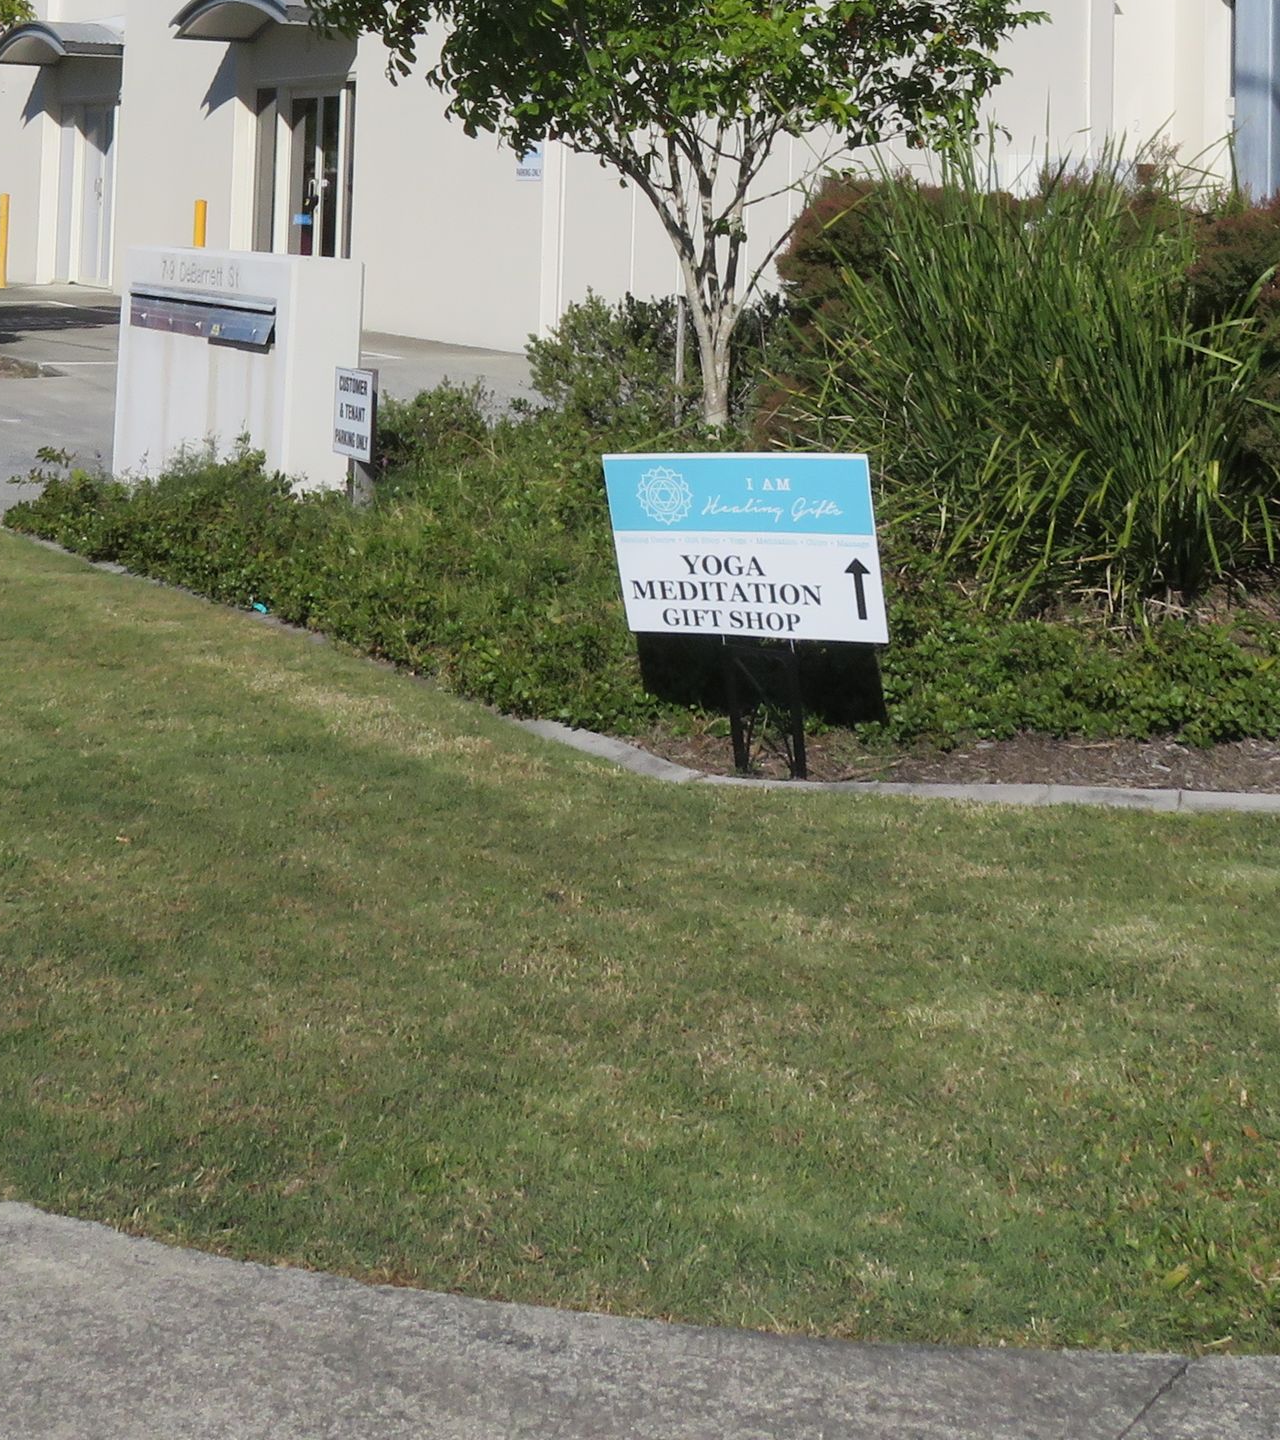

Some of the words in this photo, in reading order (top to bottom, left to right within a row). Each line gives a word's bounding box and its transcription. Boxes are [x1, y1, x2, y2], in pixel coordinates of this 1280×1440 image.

[228, 264, 240, 288] St
[338, 375, 368, 396] CUSTOMER
[339, 402, 344, 418] &
[344, 403, 366, 422] TENANT
[334, 428, 356, 449] PARKING
[355, 433, 369, 451] ONLY
[745, 477, 754, 492] I
[761, 477, 793, 492] AM
[700, 494, 785, 524] Healing
[791, 496, 844, 523] Gifts
[680, 554, 767, 578] YOGA
[629, 579, 823, 607] MEDITATION
[662, 607, 723, 629] GIFT
[729, 610, 802, 633] SHOP
